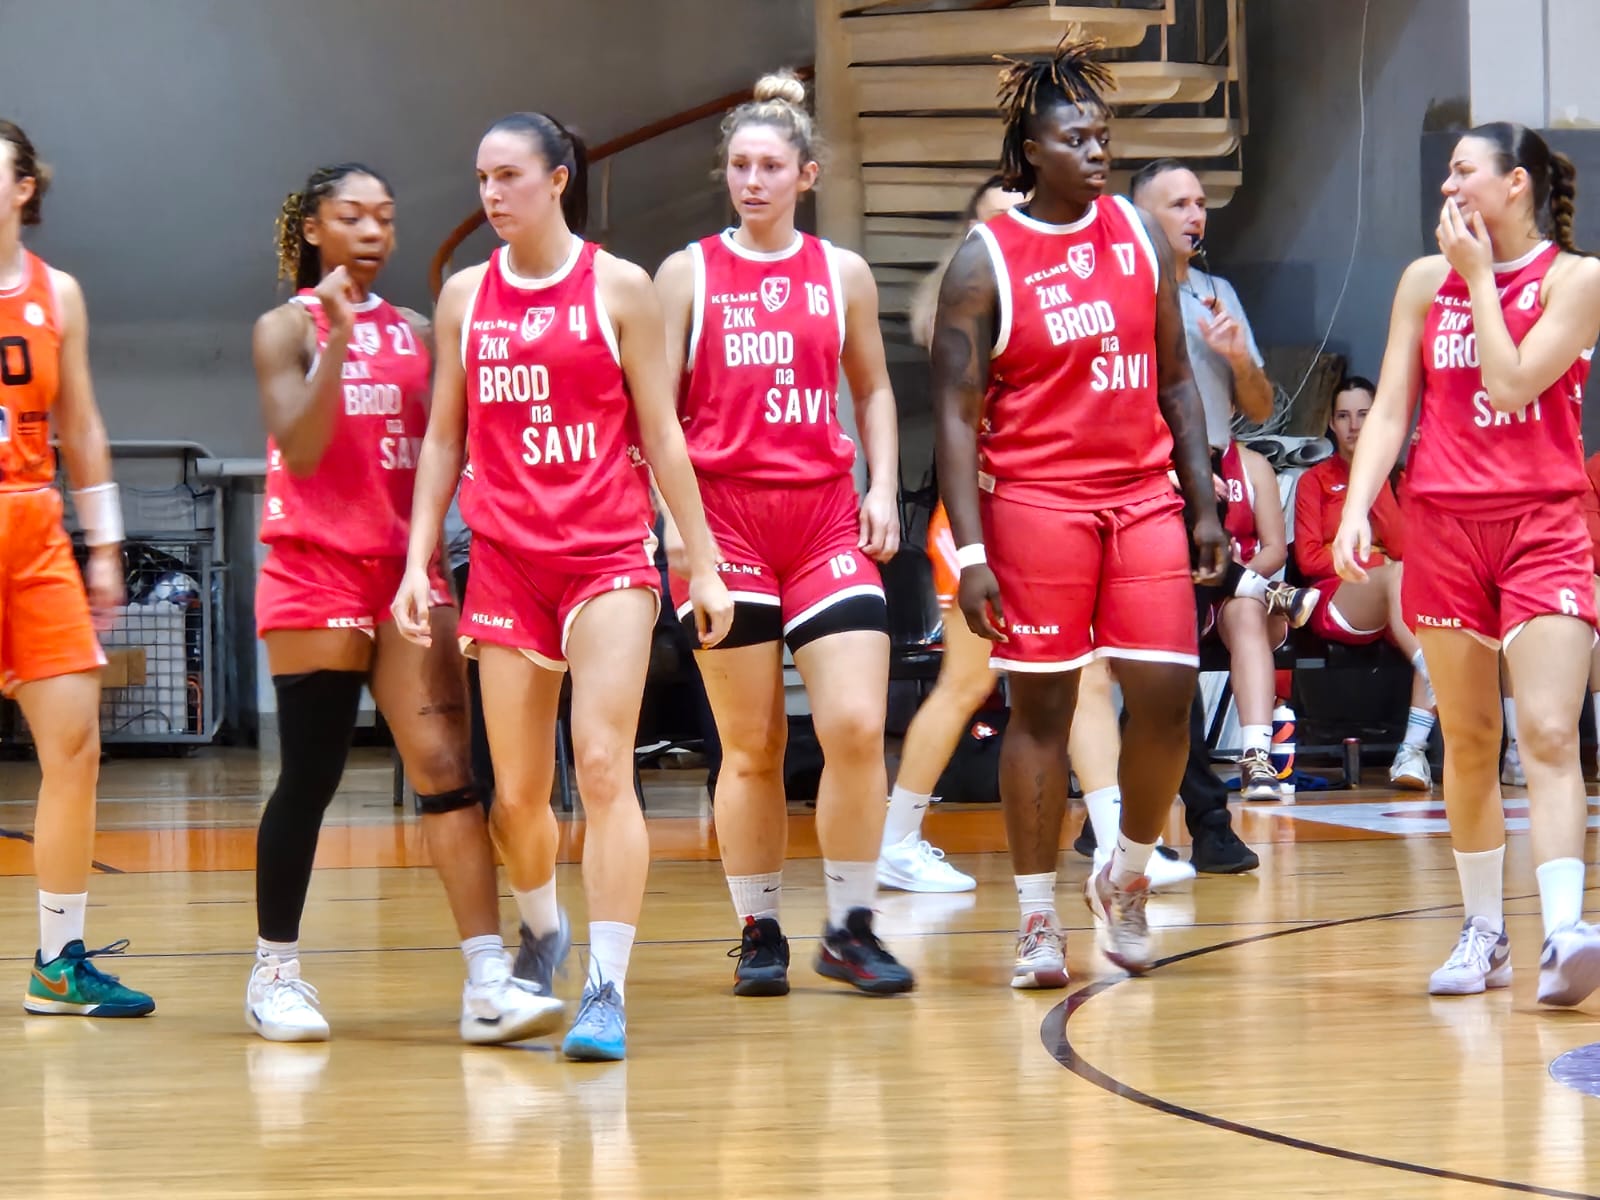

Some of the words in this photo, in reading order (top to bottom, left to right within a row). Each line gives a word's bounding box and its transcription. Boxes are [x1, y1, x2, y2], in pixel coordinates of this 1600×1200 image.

[1112, 242, 1136, 276] 17
[1024, 263, 1070, 285] KELME
[711, 292, 759, 304] KELME
[804, 282, 830, 316] 16
[1035, 284, 1072, 310] ŽKK
[1434, 294, 1472, 308] KELM
[1517, 281, 1540, 310] 6
[473, 319, 519, 332] KELME
[568, 305, 588, 341] 4
[723, 305, 757, 329] ŽKK
[1044, 300, 1116, 346] BROD
[386, 322, 417, 356] 21
[478, 333, 510, 360] ŽKK
[724, 330, 794, 367] BROD
[1100, 335, 1120, 353] na
[1433, 333, 1481, 369] BRO
[479, 364, 550, 403] BROD
[775, 368, 795, 385] na
[1090, 353, 1148, 392] SAVI
[344, 384, 402, 415] BROD
[764, 387, 830, 425] SAVI
[531, 405, 553, 423] na
[522, 422, 597, 465] SAVI
[472, 612, 514, 629] KELME
[1012, 624, 1059, 635] KELME
[1416, 614, 1462, 627] KELME
